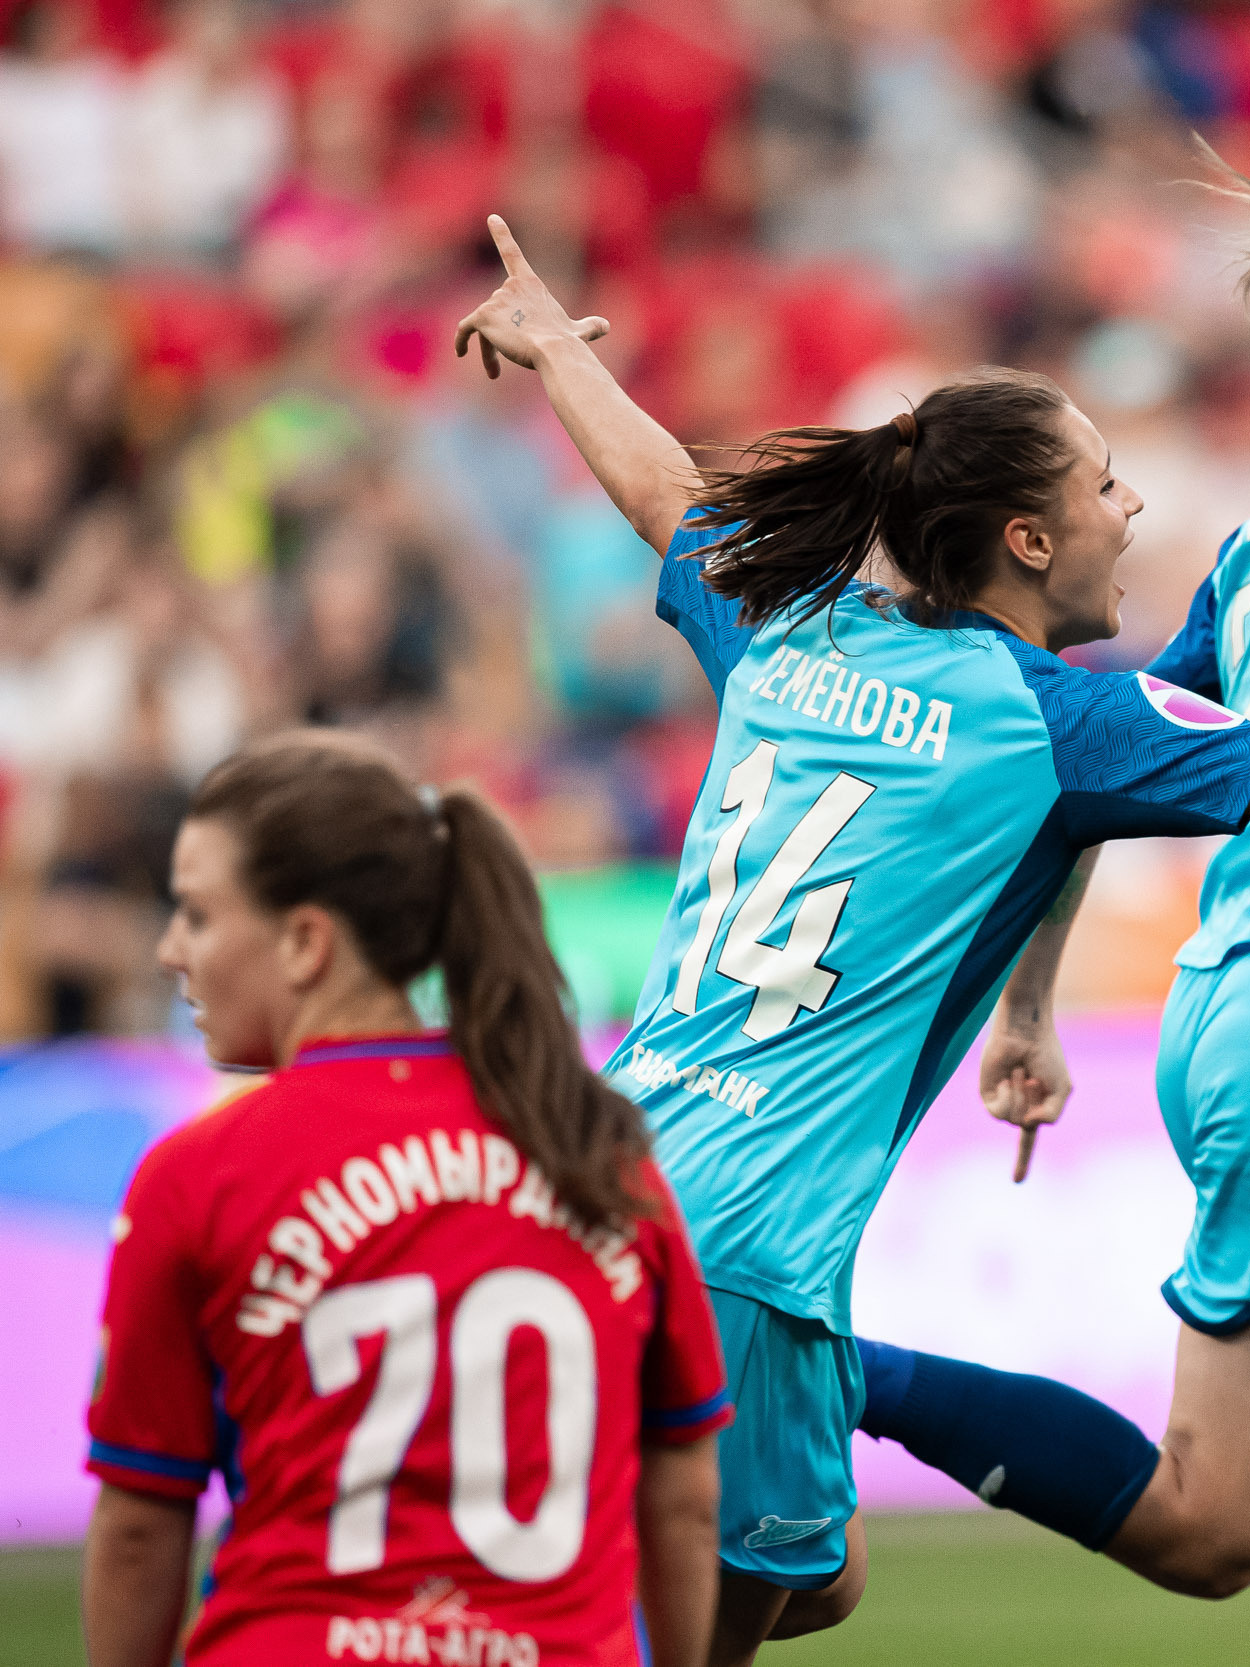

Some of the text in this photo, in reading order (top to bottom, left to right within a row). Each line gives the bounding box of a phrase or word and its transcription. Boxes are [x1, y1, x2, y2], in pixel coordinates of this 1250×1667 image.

[749, 644, 953, 761] СЕМЁНОВА
[672, 738, 878, 1042] 14
[301, 1266, 597, 1584] 70
[325, 1615, 540, 1667] РОТА-АГРО
